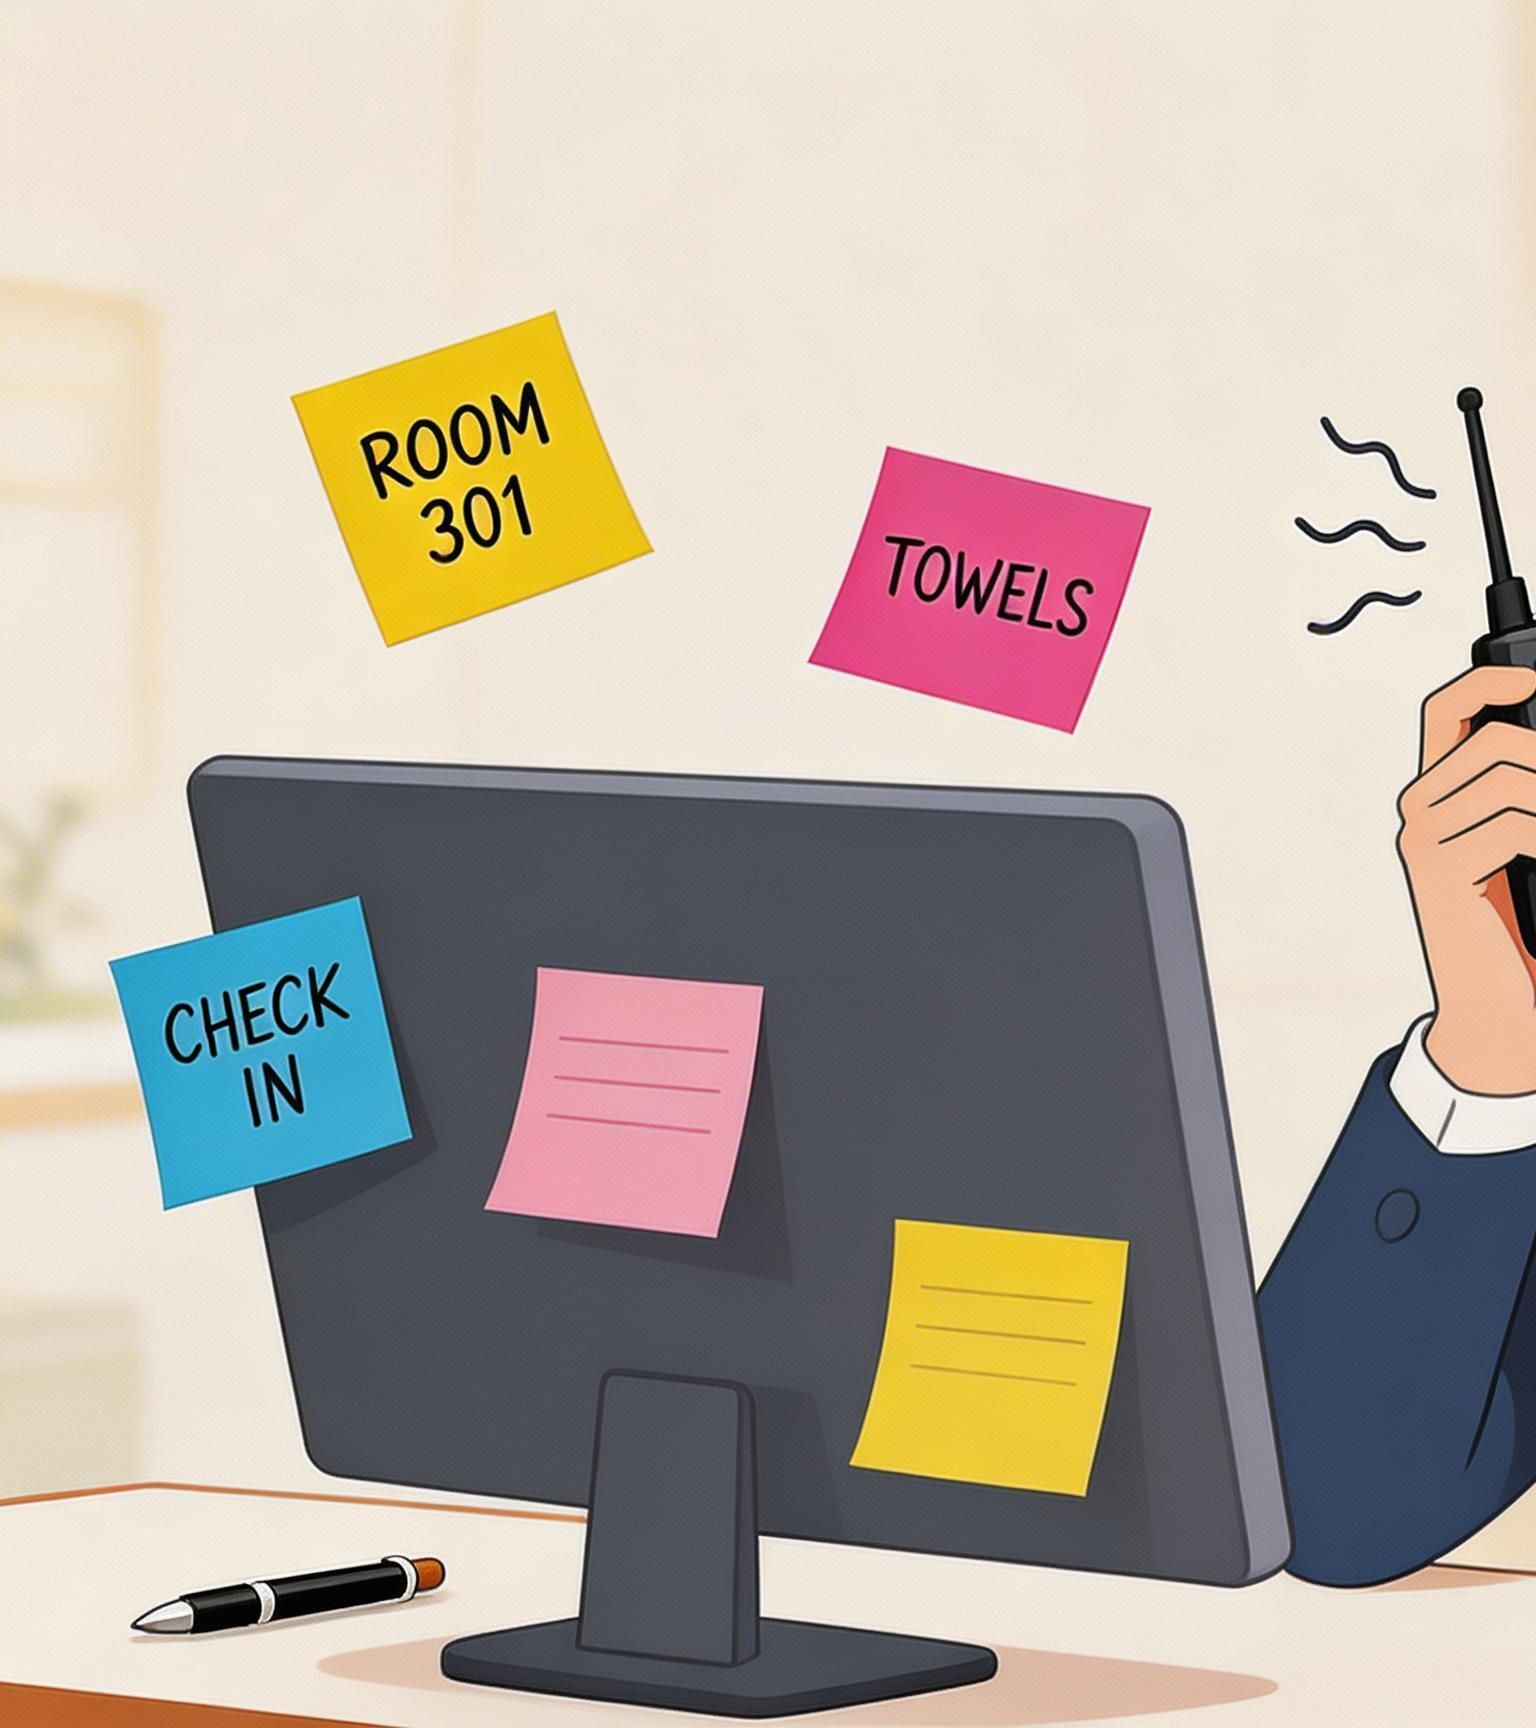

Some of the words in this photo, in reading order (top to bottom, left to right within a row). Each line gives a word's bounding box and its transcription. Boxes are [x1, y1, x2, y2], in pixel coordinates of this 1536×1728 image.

[360, 381, 550, 499] ROOM
[420, 474, 533, 564] 301
[885, 535, 1094, 638] TOWELS
[165, 961, 350, 1064] CHECK
[243, 1053, 305, 1128] IN
